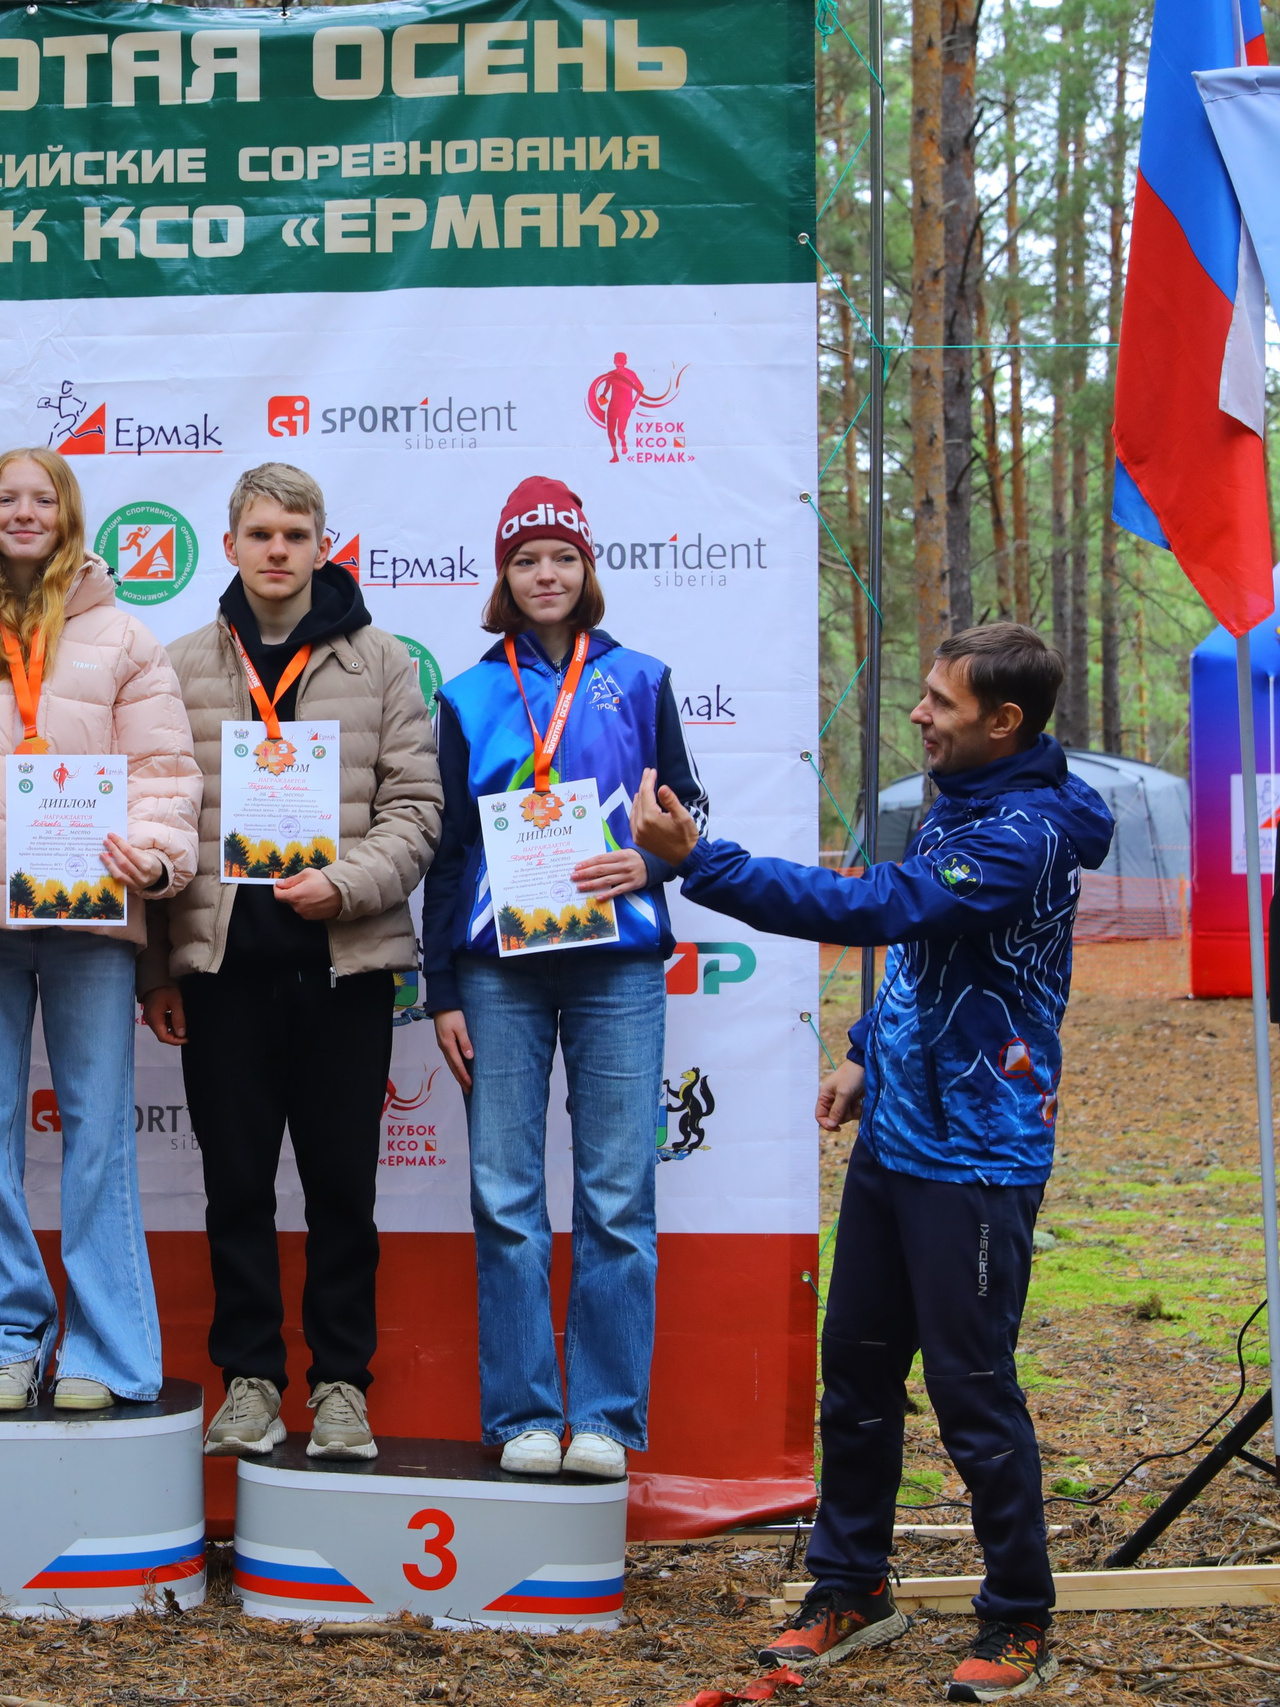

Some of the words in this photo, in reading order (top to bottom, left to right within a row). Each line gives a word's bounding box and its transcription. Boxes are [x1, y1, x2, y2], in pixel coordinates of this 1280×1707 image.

[312, 18, 688, 102] ОСЕНЬ
[238, 135, 660, 182] СОРЕВНОВАНИЯ
[84, 204, 244, 261] КСО
[281, 192, 660, 254] «ЕРМАК»
[321, 396, 518, 434] SPORTident
[115, 413, 222, 456] Ермак
[635, 422, 685, 433] КУБОК
[405, 434, 477, 450] siberia
[635, 437, 667, 448] КСО
[627, 452, 696, 463] «ЕРМАК»
[125, 506, 178, 522] СПОРТИВНОГО
[501, 503, 595, 551] adida
[594, 533, 767, 570] PORTident
[370, 546, 478, 588] Ермак
[654, 571, 727, 587] siberia
[278, 743, 288, 754] 3
[38, 799, 96, 809] ДИПЛОМ
[545, 797, 556, 808] 3
[516, 825, 572, 844] ДИПЛОМ
[387, 1125, 436, 1136] КУБОК
[387, 1140, 418, 1151] КСО
[378, 1156, 447, 1167] «ЕРМАК»
[978, 1223, 989, 1297] NORDSKI
[402, 1509, 457, 1592] 3
